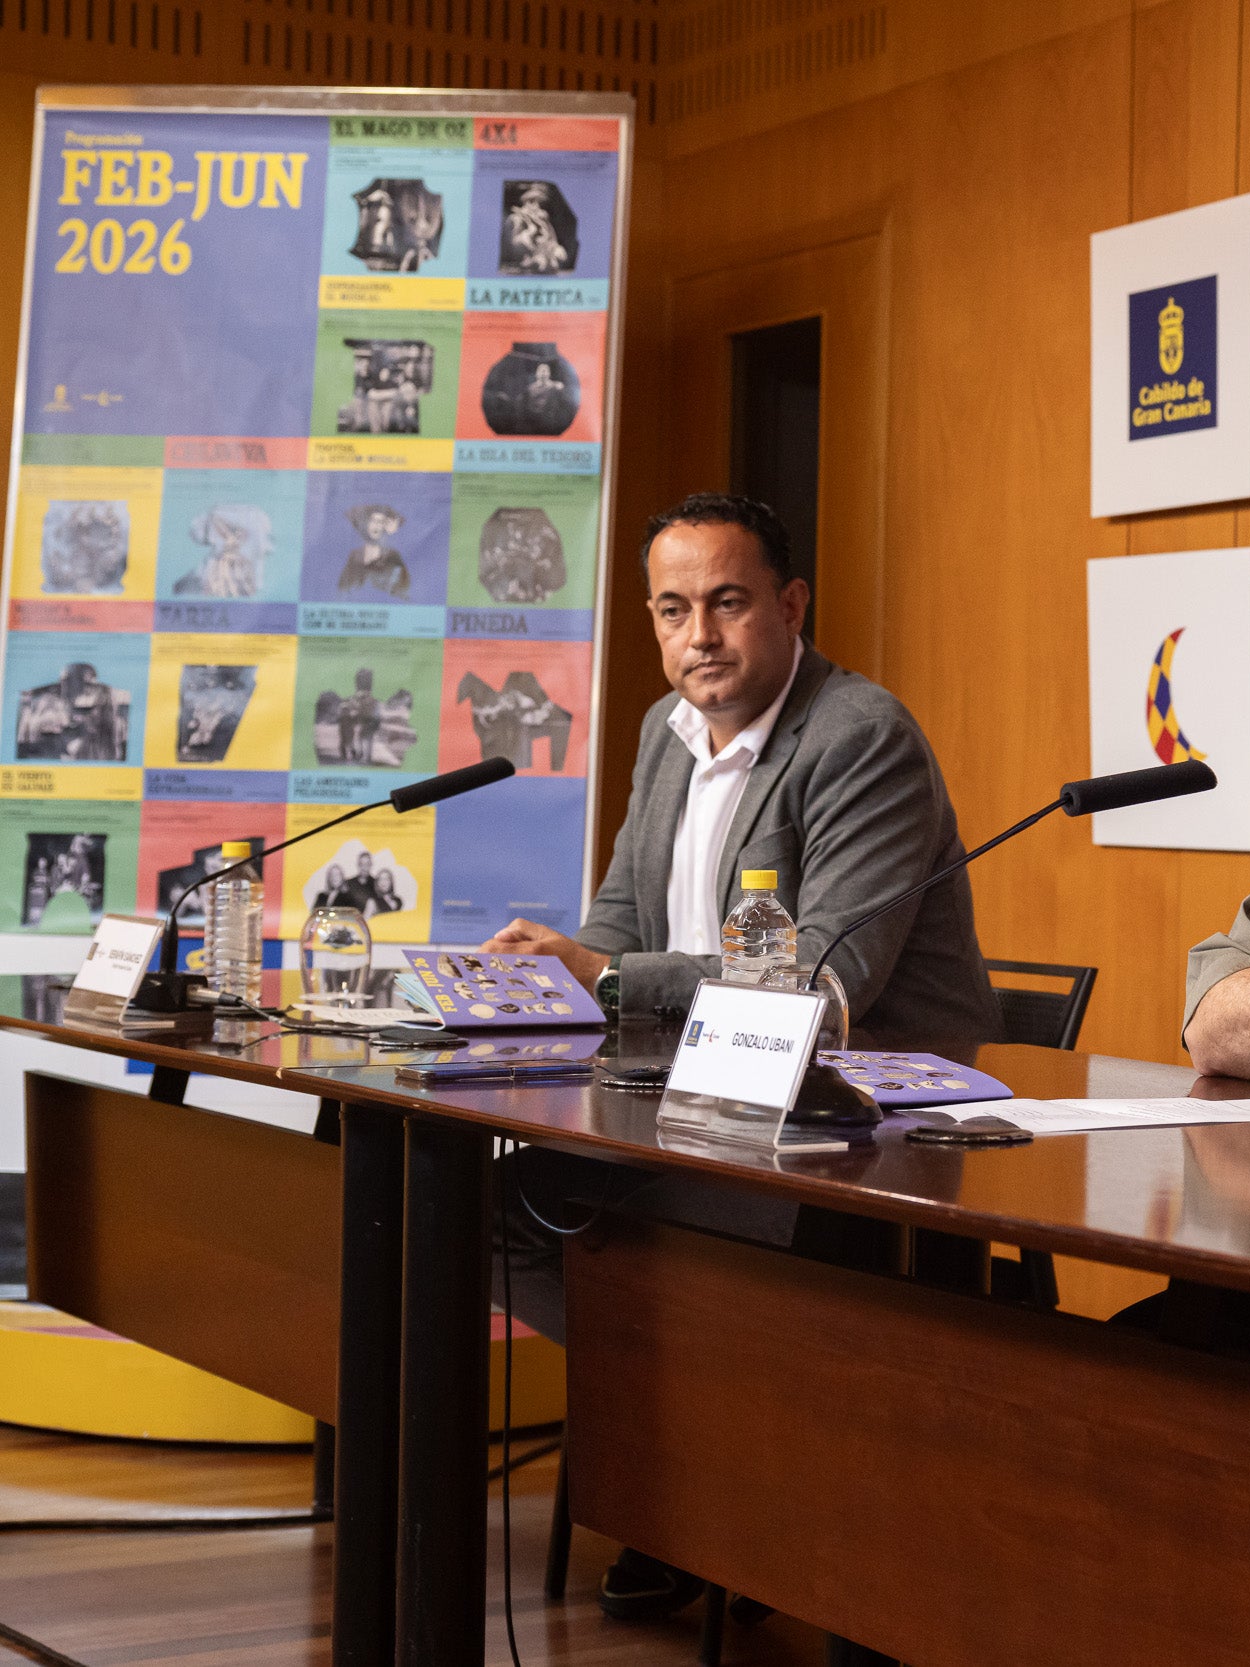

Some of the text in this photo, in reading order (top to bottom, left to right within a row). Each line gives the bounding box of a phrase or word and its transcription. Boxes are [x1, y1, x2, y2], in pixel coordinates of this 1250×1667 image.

[335, 119, 467, 139] EL MAGO DE OZ
[57, 150, 309, 221] FEB-JUN
[55, 218, 192, 275] 2026
[470, 289, 492, 304] LA
[500, 284, 584, 306] PATÉTICA
[1138, 376, 1205, 406] Cabildo de
[1132, 395, 1211, 427] Gran Canaria
[453, 612, 528, 634] PINEDA
[732, 1032, 769, 1050] GONZALO
[769, 1038, 795, 1054] UBANI
